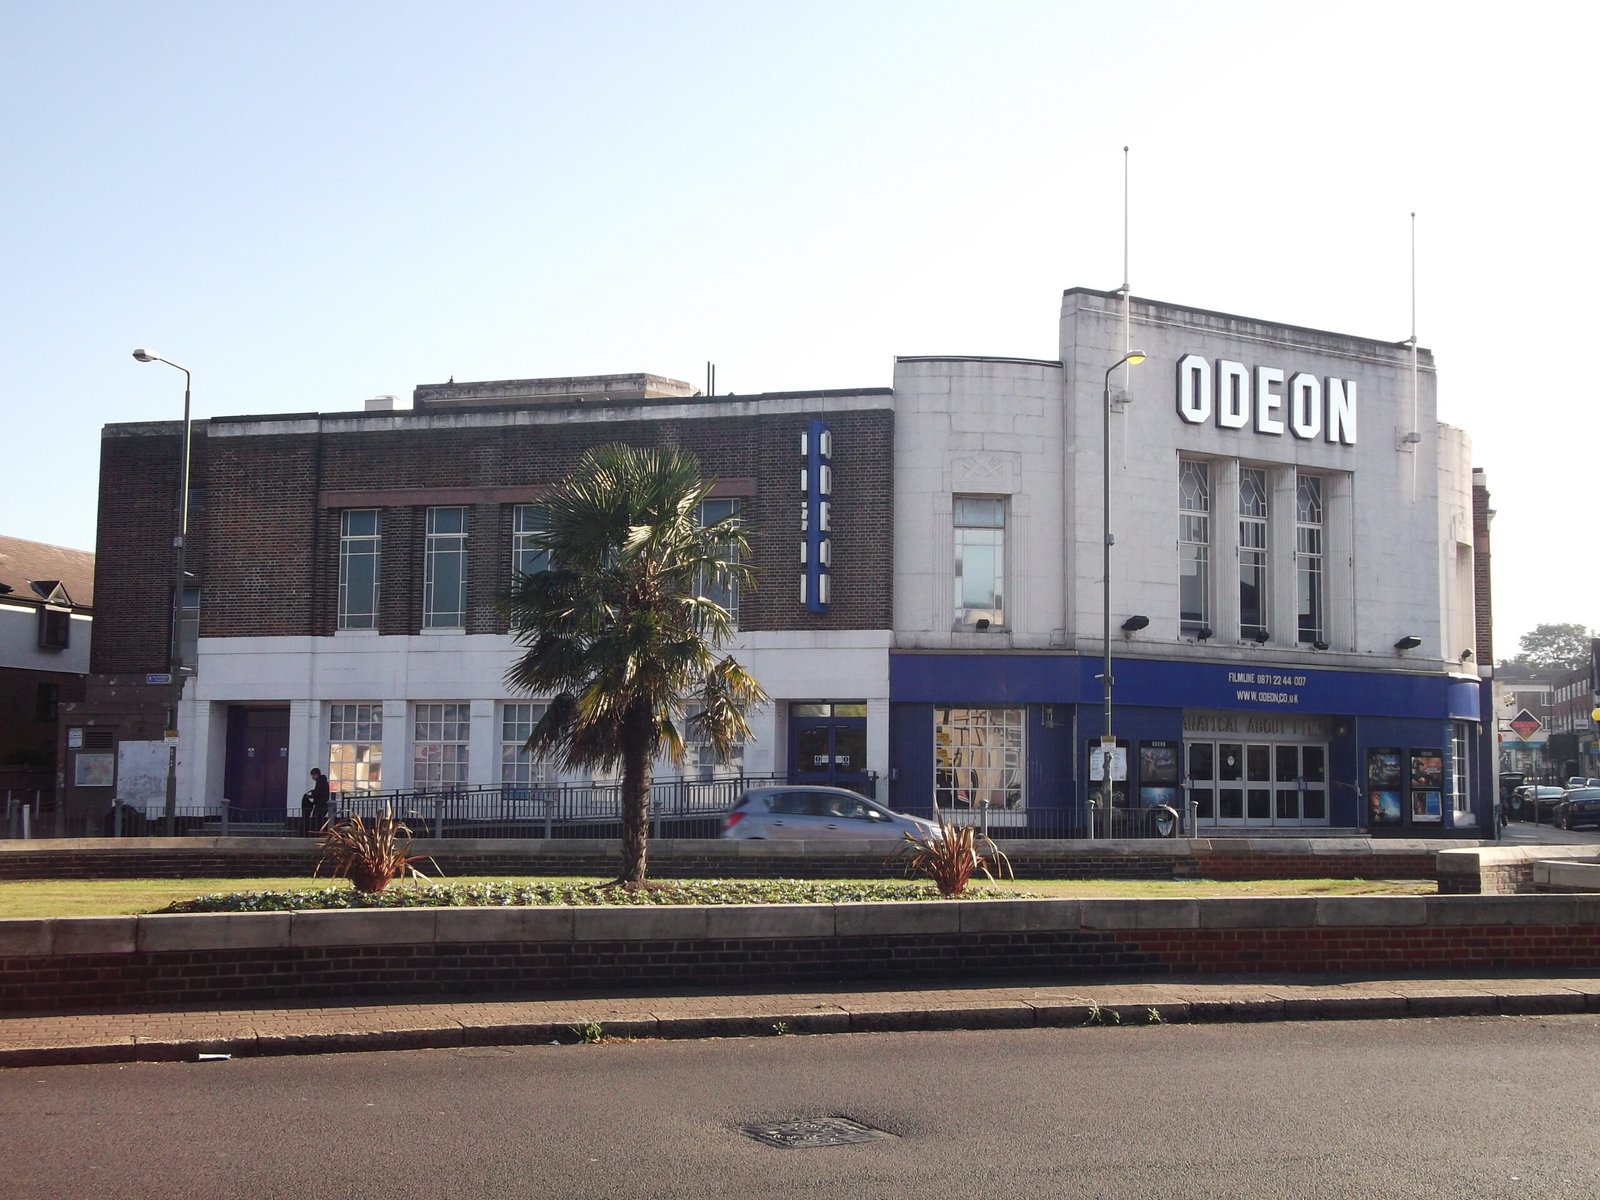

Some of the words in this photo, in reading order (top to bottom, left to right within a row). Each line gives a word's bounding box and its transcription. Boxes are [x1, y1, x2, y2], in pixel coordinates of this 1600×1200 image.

[1176, 353, 1357, 444] ODEON
[1228, 672, 1255, 683] FILMLINE
[1257, 674, 1272, 684] 0871
[1273, 675, 1281, 685] 22
[1282, 676, 1292, 685] 44
[1294, 676, 1306, 686] 007
[1246, 718, 1285, 734] ABOUT
